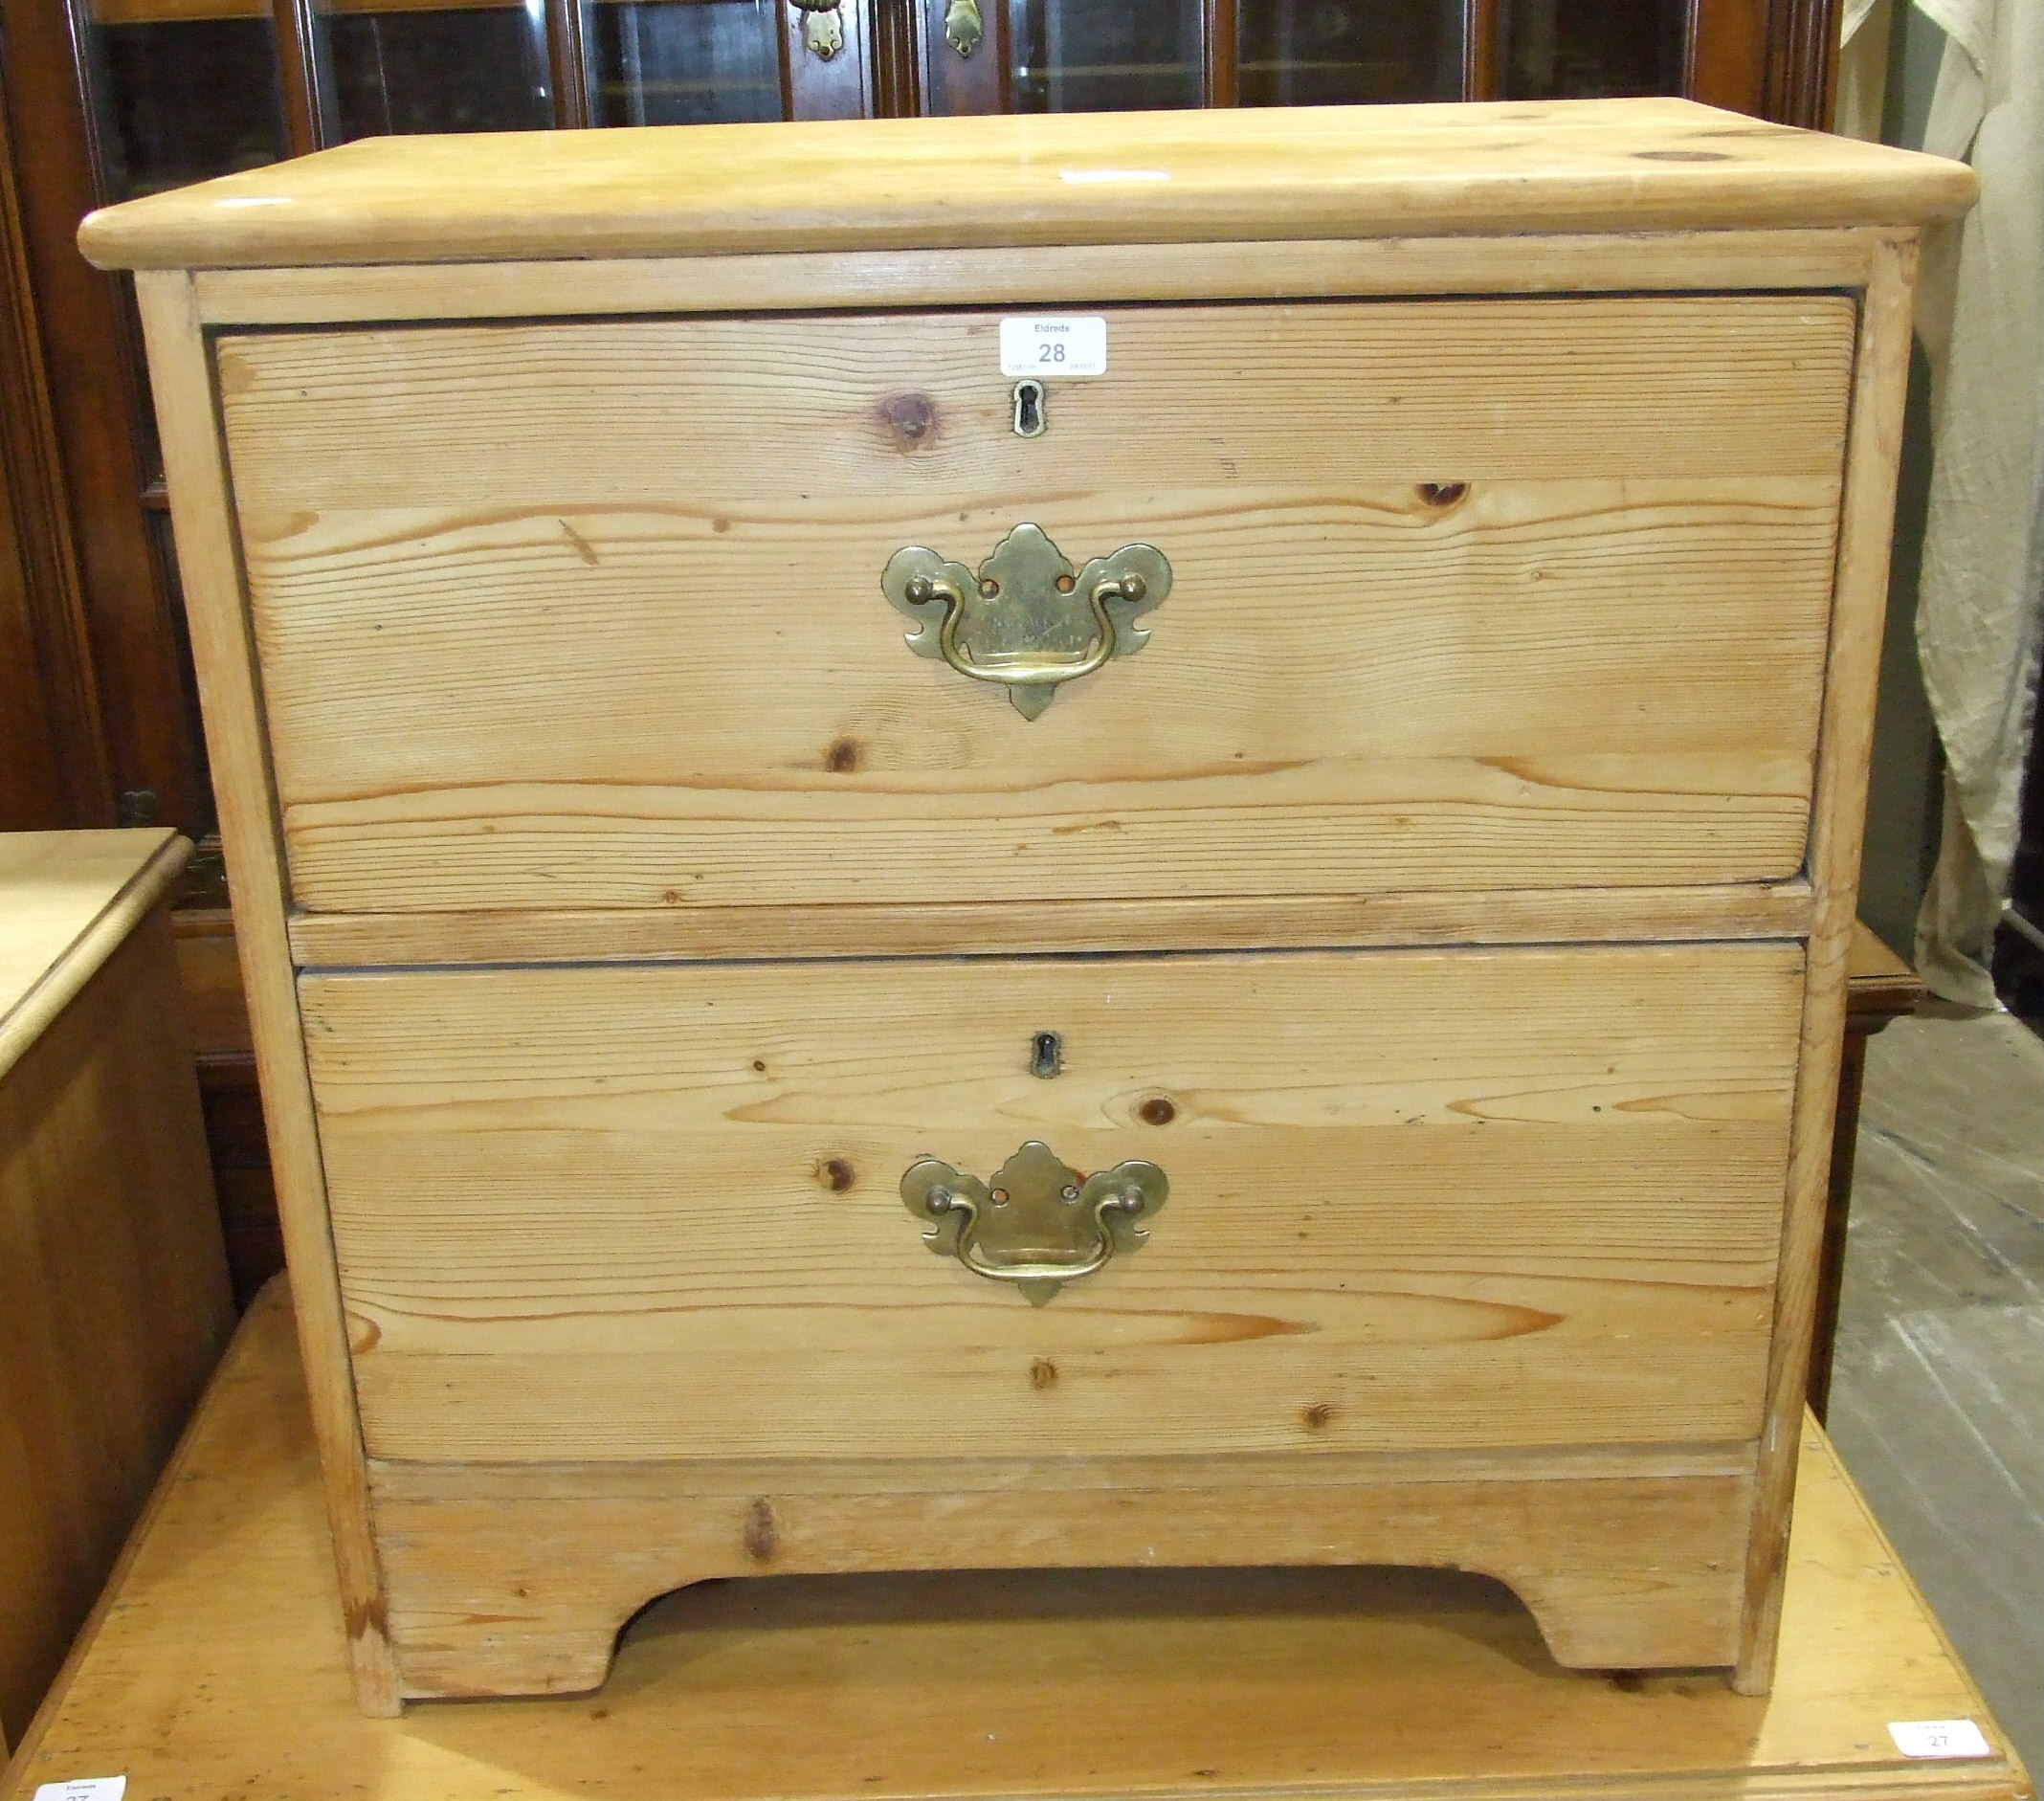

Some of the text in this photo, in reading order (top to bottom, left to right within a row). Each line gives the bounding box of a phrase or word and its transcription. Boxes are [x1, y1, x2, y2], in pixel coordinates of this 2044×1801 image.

[1034, 323, 1070, 332] Eldreds
[1039, 344, 1065, 363] 28
[1927, 1735, 1948, 1746] 27
